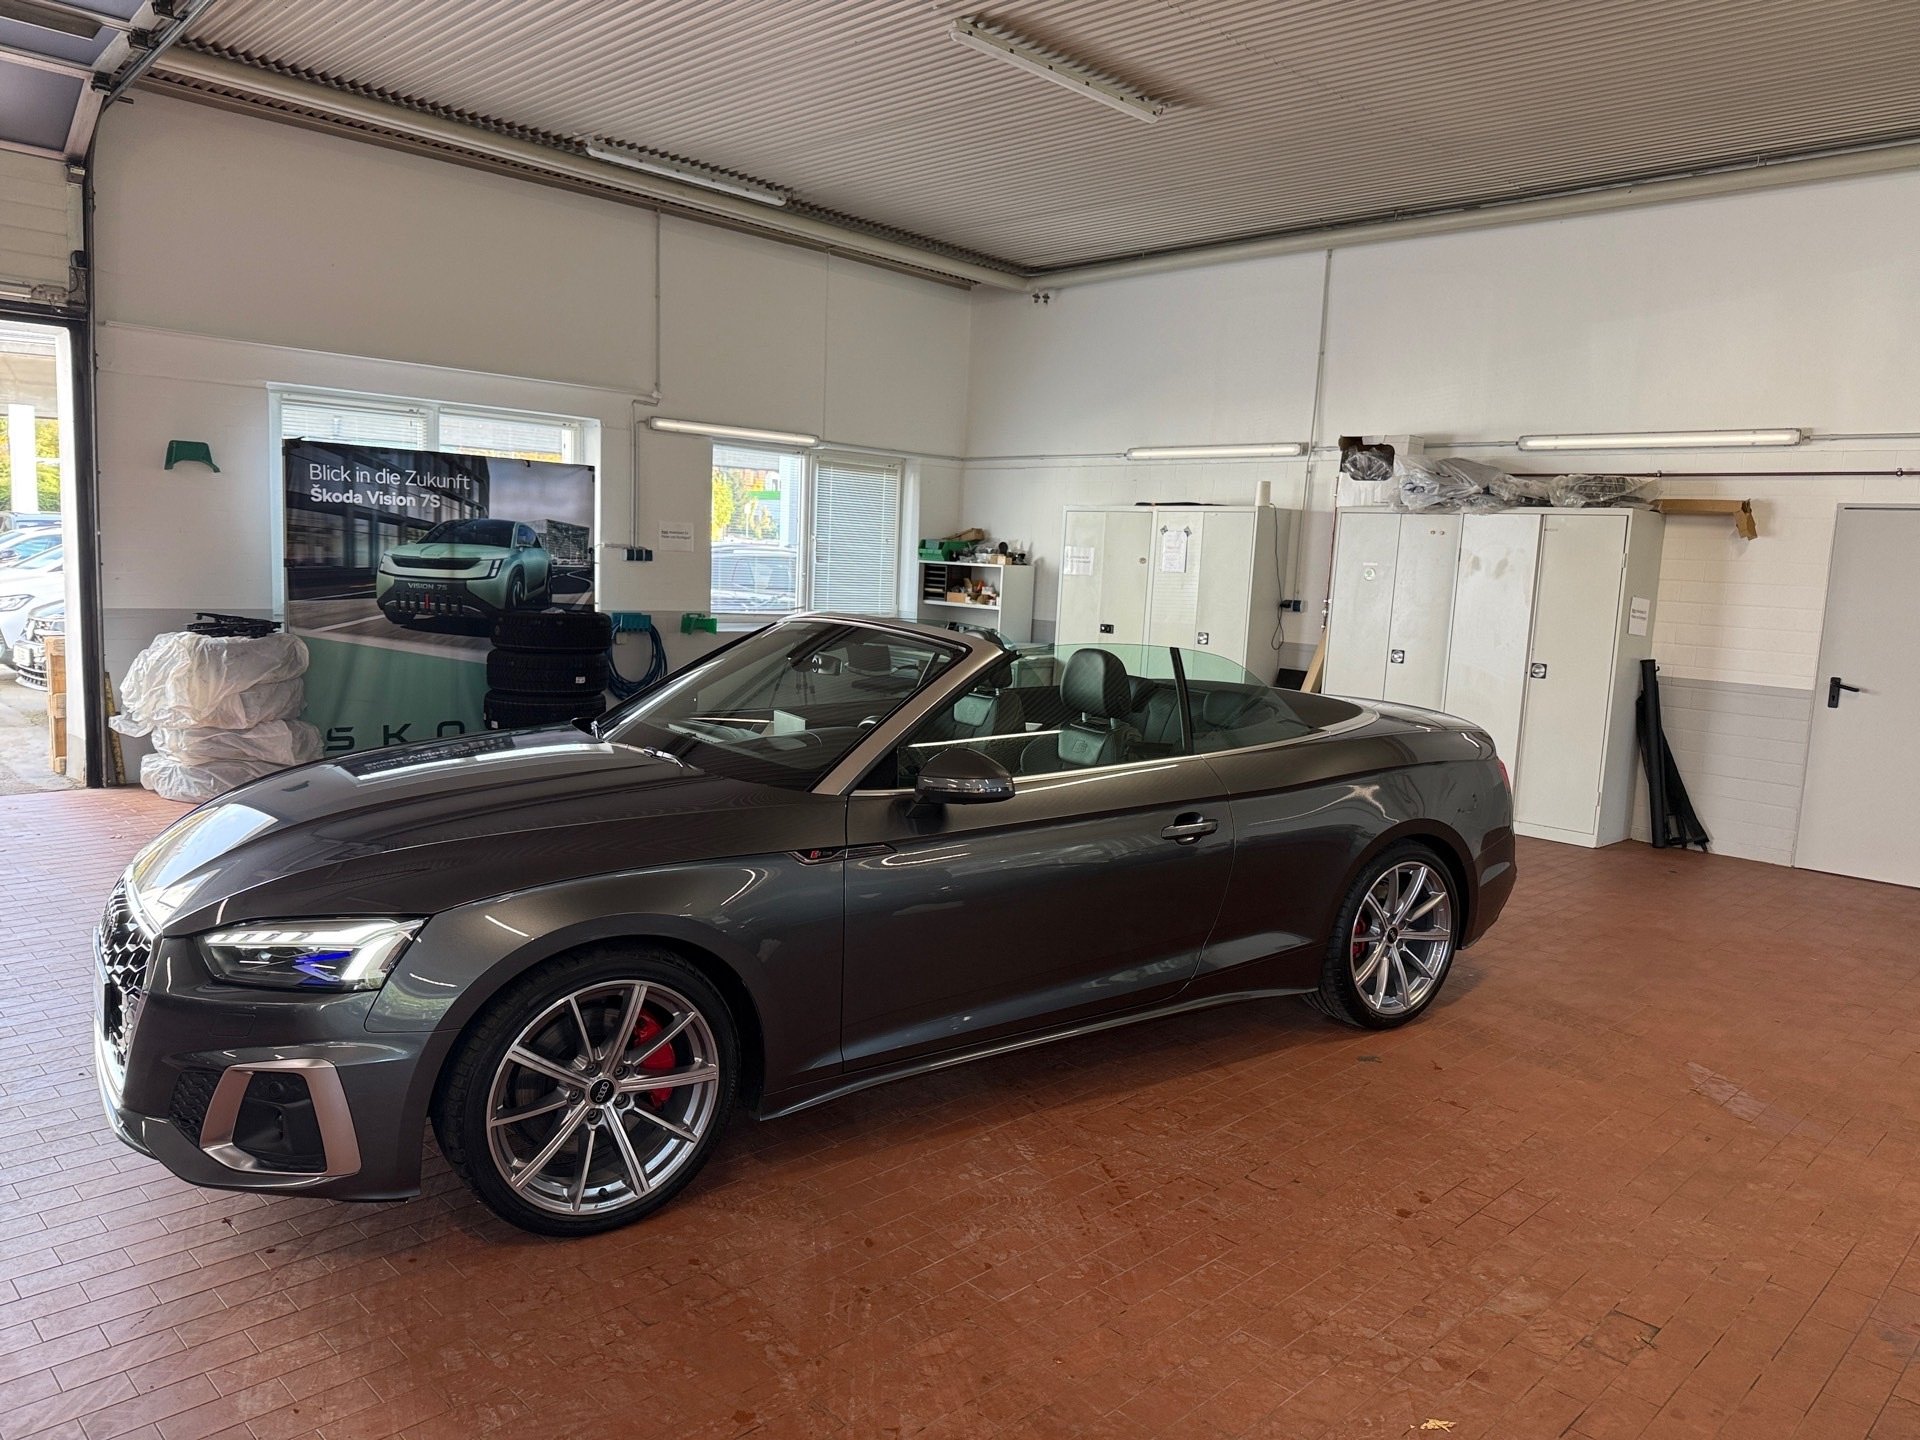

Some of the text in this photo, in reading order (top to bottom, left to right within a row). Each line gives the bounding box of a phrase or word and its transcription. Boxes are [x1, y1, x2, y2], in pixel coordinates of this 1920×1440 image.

[309, 463, 471, 490] Blick in die Zukunft
[310, 483, 441, 508] Škoda Vision 7S
[407, 582, 434, 590] VISION
